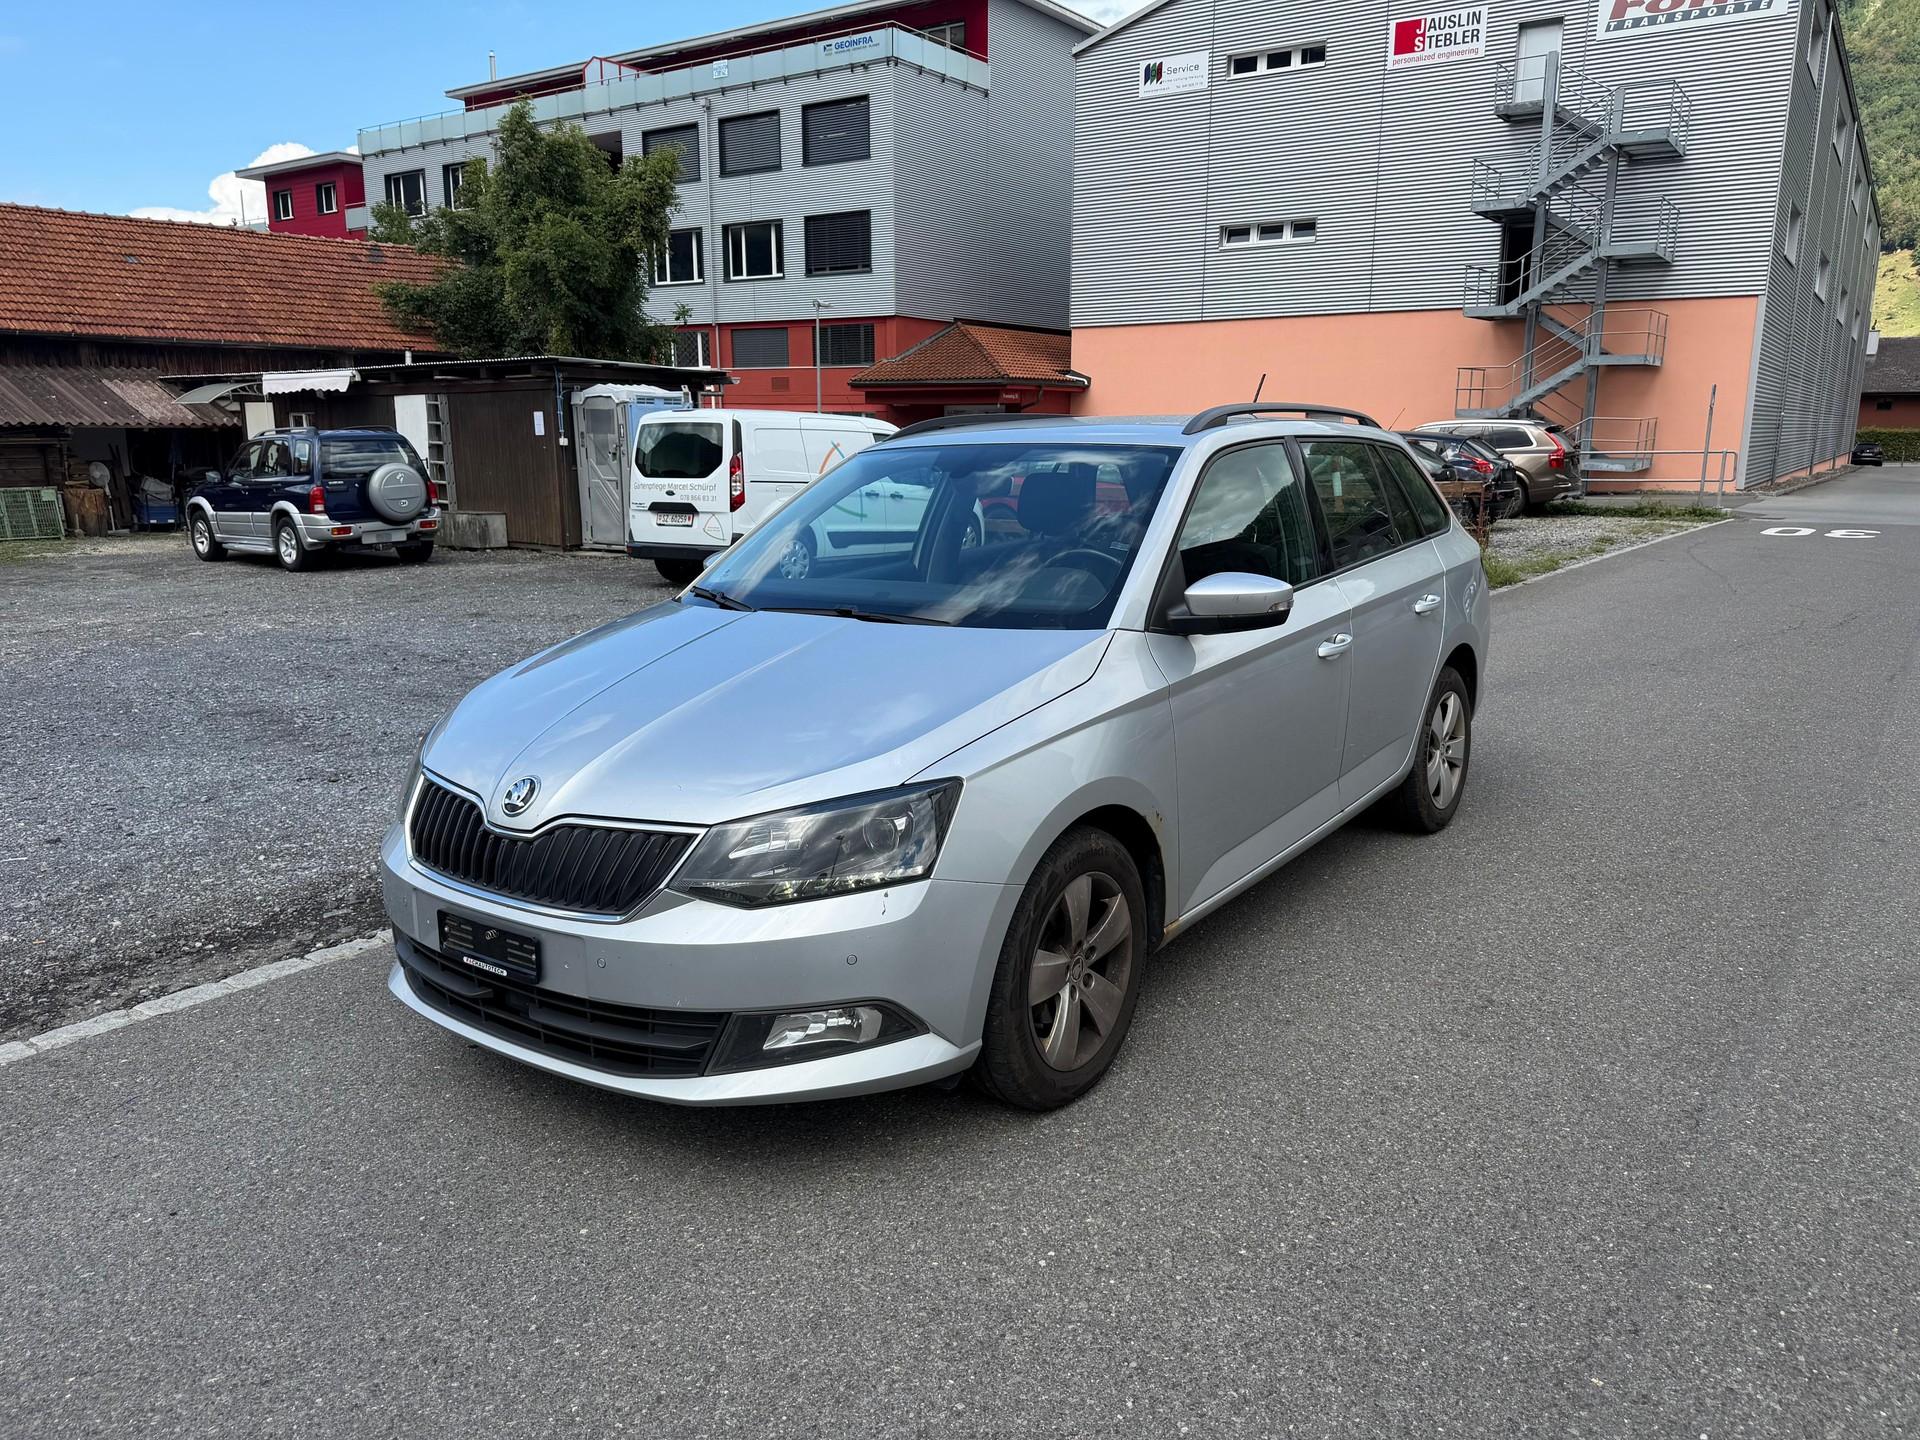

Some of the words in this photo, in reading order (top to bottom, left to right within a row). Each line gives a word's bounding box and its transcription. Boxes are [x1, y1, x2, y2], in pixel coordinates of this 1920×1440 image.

[1416, 10, 1481, 35] JAUSLIN
[1609, 0, 1769, 31] TRANSPORTE
[834, 36, 873, 50] GEOINFRA
[1414, 28, 1480, 52] STEBLER
[1392, 53, 1436, 67] personalized
[1437, 47, 1479, 60] engineering
[633, 482, 666, 491] Gartenpflege
[668, 482, 689, 490] Marcel
[690, 482, 717, 491] Schürpf
